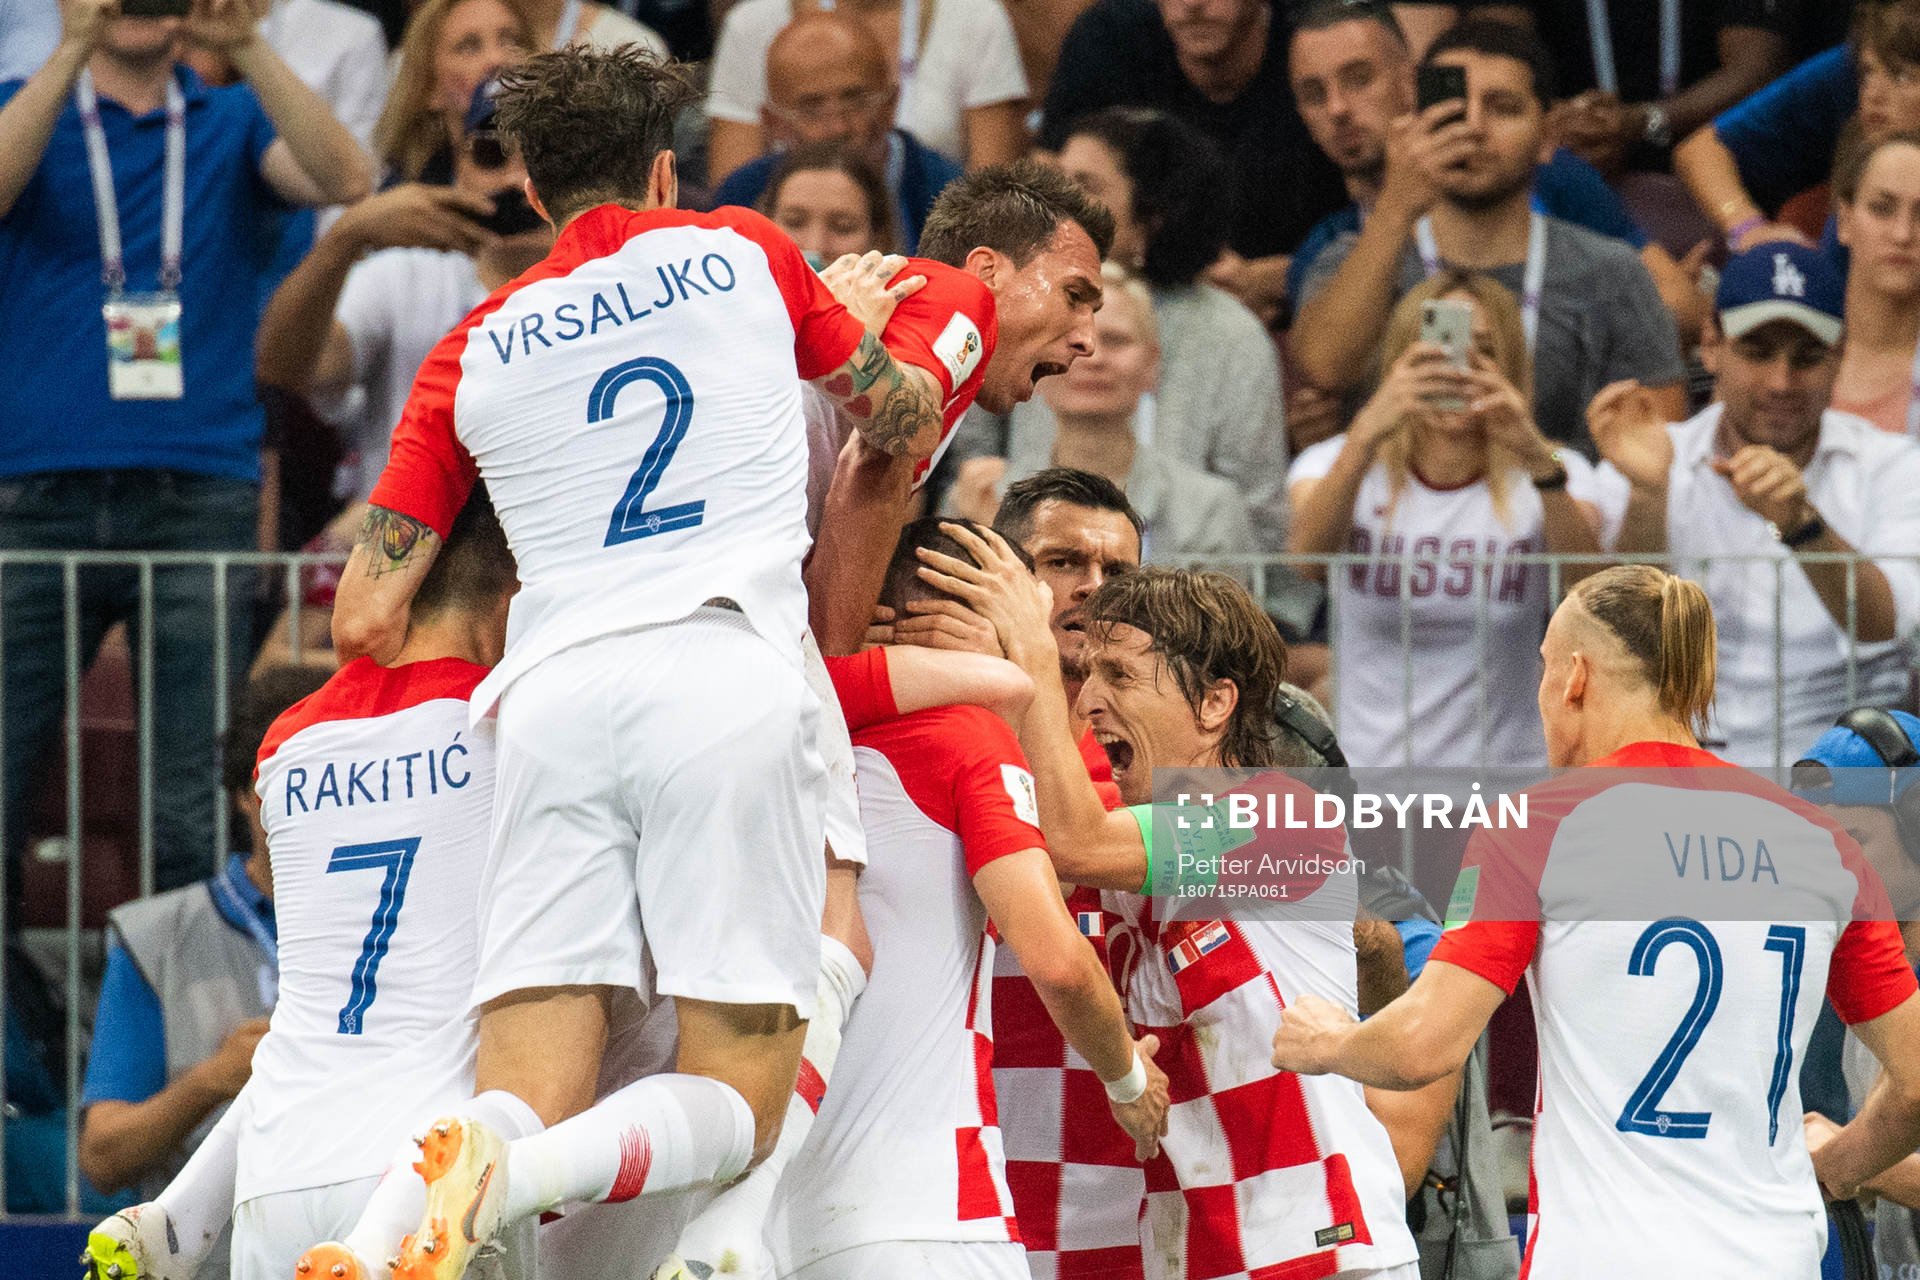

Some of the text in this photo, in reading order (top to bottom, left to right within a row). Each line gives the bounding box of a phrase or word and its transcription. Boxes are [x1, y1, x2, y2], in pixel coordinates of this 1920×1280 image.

[488, 253, 736, 364] VRSALJKO
[587, 356, 706, 548] 2
[286, 732, 471, 816] RAKITIĆ
[1664, 832, 1779, 885] VIDA
[325, 836, 422, 1035] 7
[1616, 915, 1806, 1147] 21
